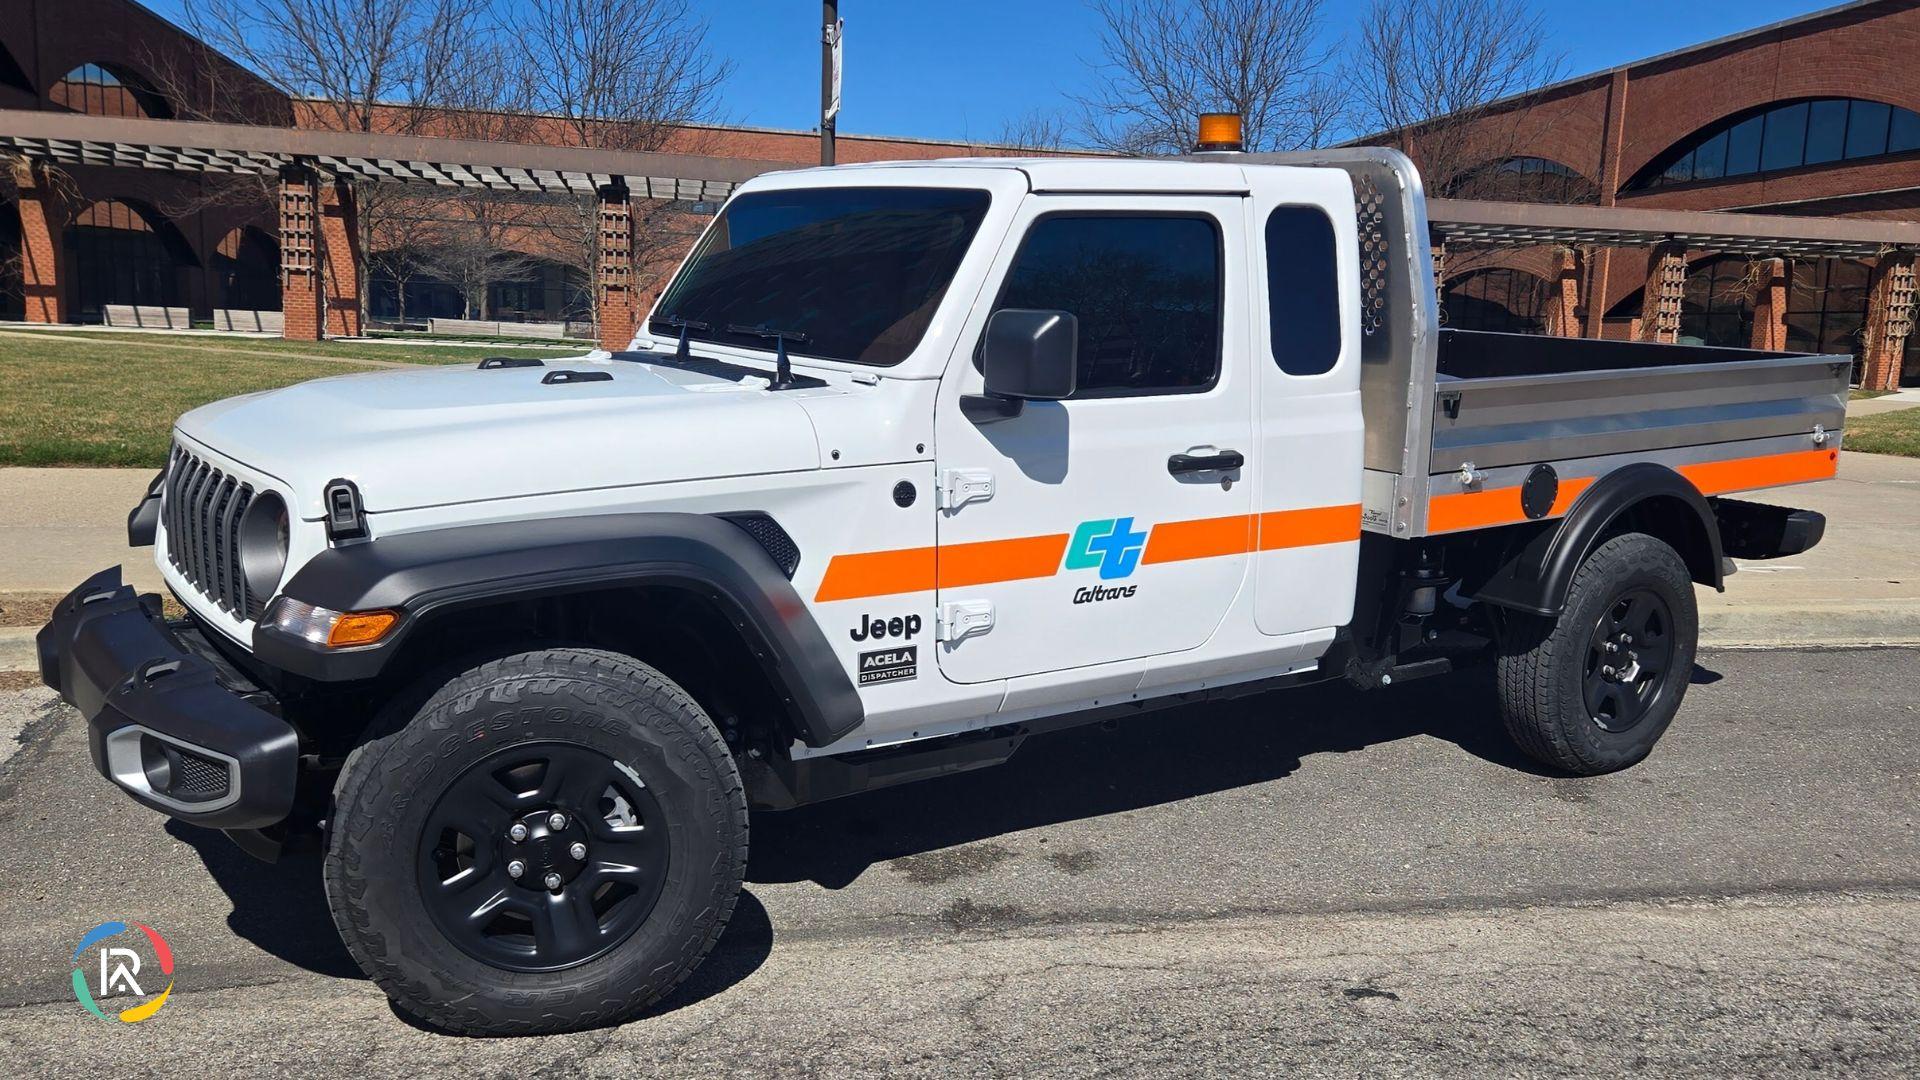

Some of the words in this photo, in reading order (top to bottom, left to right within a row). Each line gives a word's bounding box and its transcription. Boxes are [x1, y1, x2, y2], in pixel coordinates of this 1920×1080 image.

[1073, 585, 1137, 604] Caltrans
[850, 614, 921, 642] Jeep
[864, 651, 912, 667] ACELA
[861, 668, 914, 681] DISPATCHER
